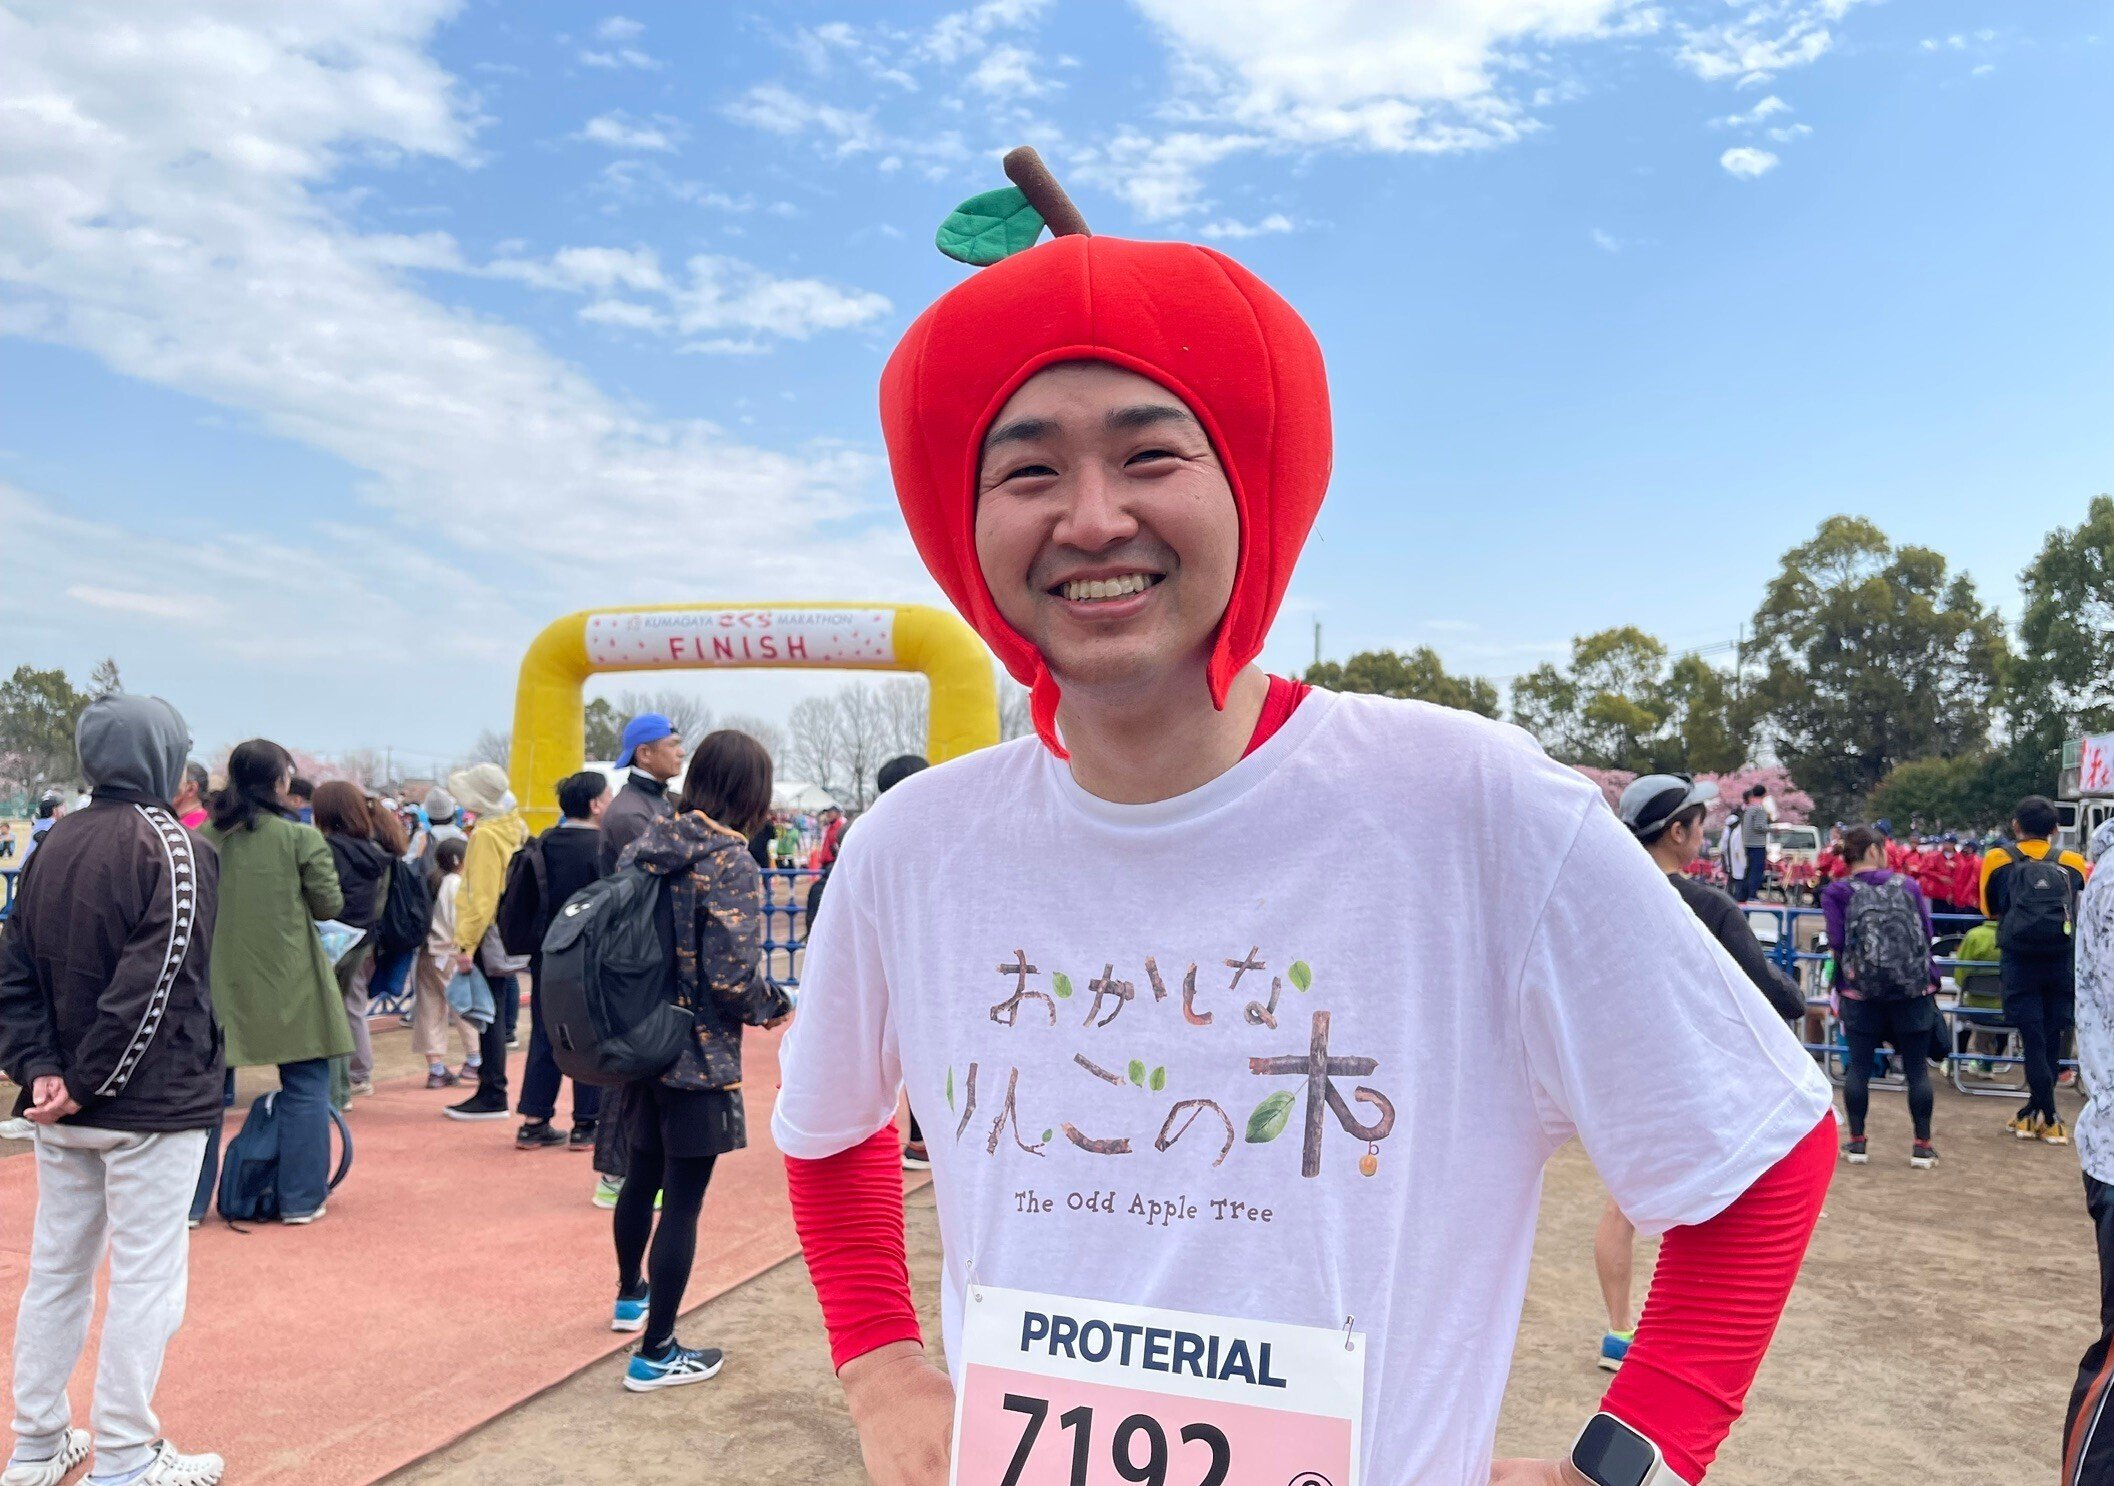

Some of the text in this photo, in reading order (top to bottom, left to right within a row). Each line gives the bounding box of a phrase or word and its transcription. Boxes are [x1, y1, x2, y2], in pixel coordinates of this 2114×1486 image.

[644, 614, 713, 629] KUMAGAYA
[777, 613, 853, 627] MARATHON
[668, 635, 809, 661] FINISH
[989, 945, 1312, 1030] おかしな
[945, 1010, 1396, 1179] りんごの木
[1014, 1189, 1274, 1227] The Odd Apple Tree
[1020, 1310, 1288, 1389] PROTERIAL
[1000, 1392, 1231, 1486] 7192
